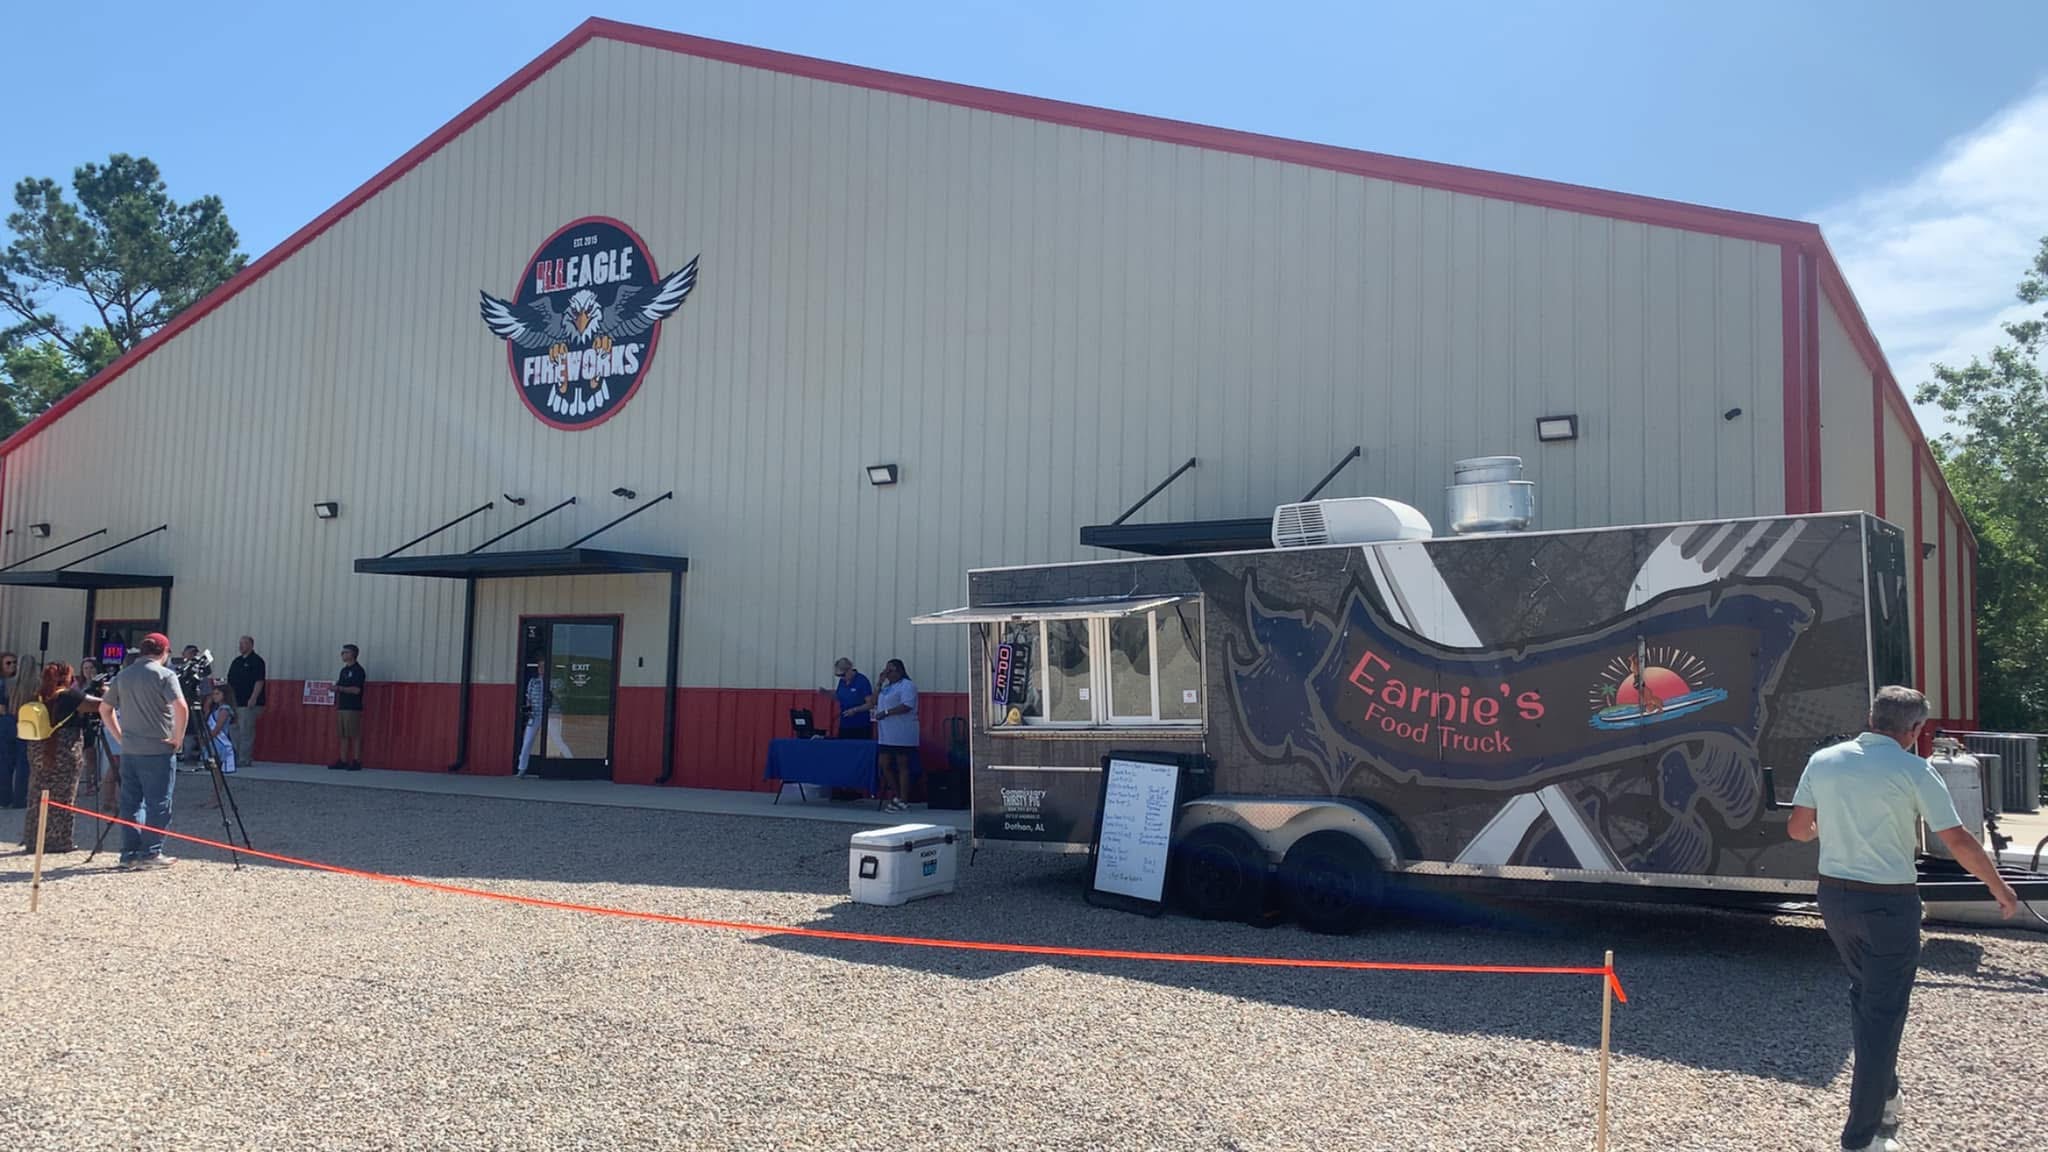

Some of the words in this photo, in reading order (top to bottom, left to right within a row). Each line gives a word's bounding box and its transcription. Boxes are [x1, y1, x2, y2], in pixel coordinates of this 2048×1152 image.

[584, 234, 598, 246] 2015
[572, 663, 590, 671] EXIT
[995, 648, 1009, 701] OPEN
[1347, 650, 1545, 725] Earnie's
[1364, 703, 1429, 745] Food
[1437, 725, 1512, 752] Truck
[1004, 822, 1033, 832] Dothan,
[1034, 823, 1046, 832] AL
